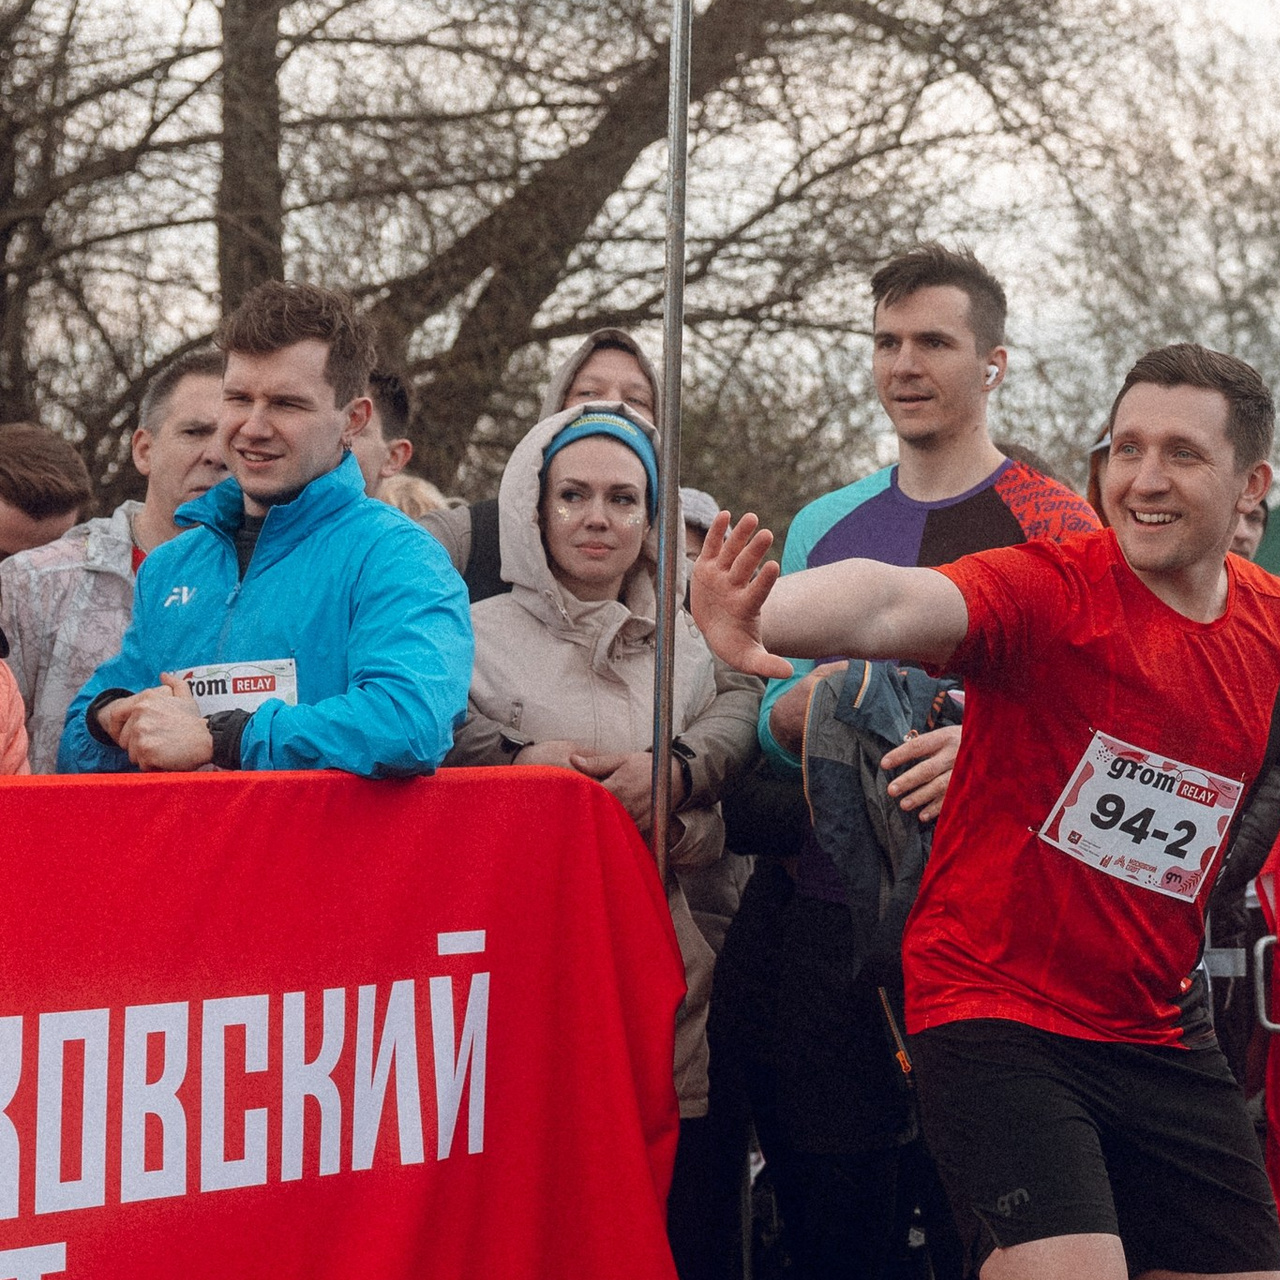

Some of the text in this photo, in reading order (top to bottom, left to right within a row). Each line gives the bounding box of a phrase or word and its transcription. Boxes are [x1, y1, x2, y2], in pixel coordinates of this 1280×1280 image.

[189, 678, 272, 697] rom RELAY
[1106, 756, 1215, 805] grom RELAY
[1090, 793, 1197, 860] 94-2
